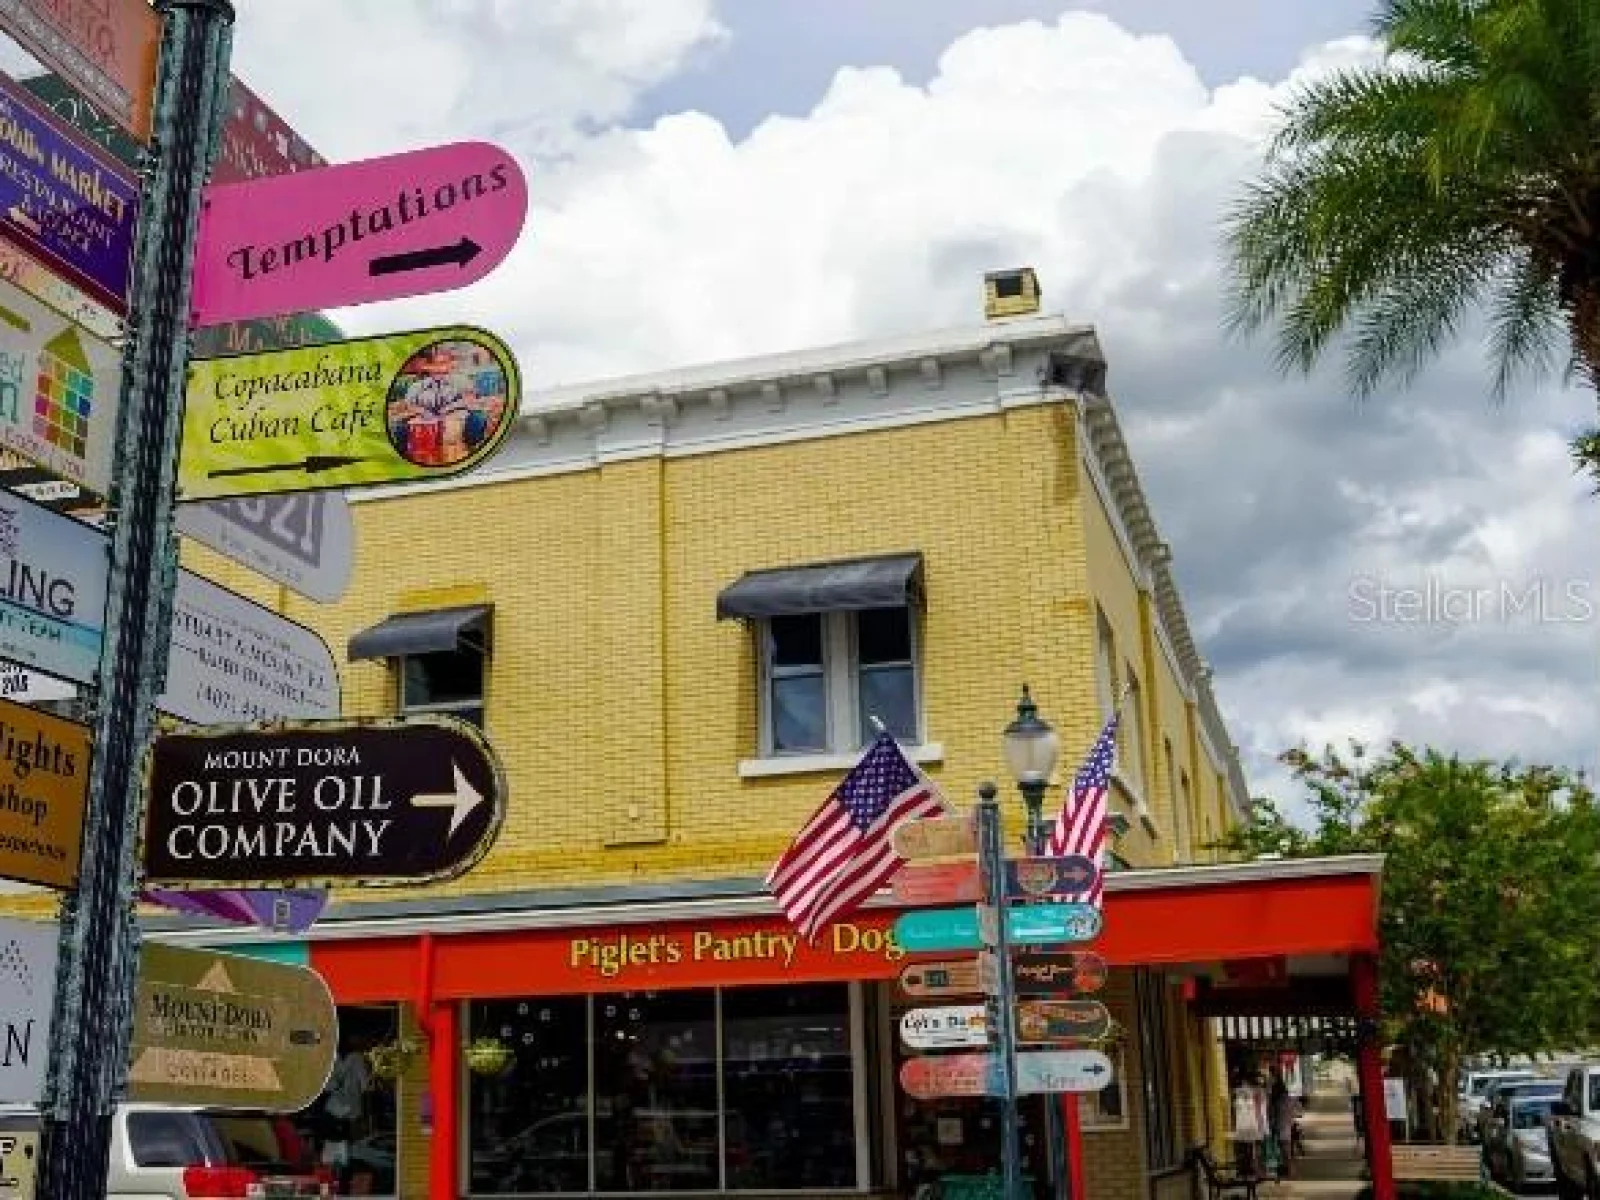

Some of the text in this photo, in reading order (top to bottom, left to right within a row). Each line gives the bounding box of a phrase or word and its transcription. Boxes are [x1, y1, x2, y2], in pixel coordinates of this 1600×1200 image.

[226, 163, 508, 279] Temptations
[214, 355, 381, 400] Copacabana
[210, 402, 374, 444] Cuban Café
[204, 746, 361, 769] MOUNT DORA
[171, 775, 392, 815] OLIVE OIL
[167, 819, 393, 859] COMPANY
[570, 934, 682, 977] Piglet's
[693, 931, 798, 968] Pantry
